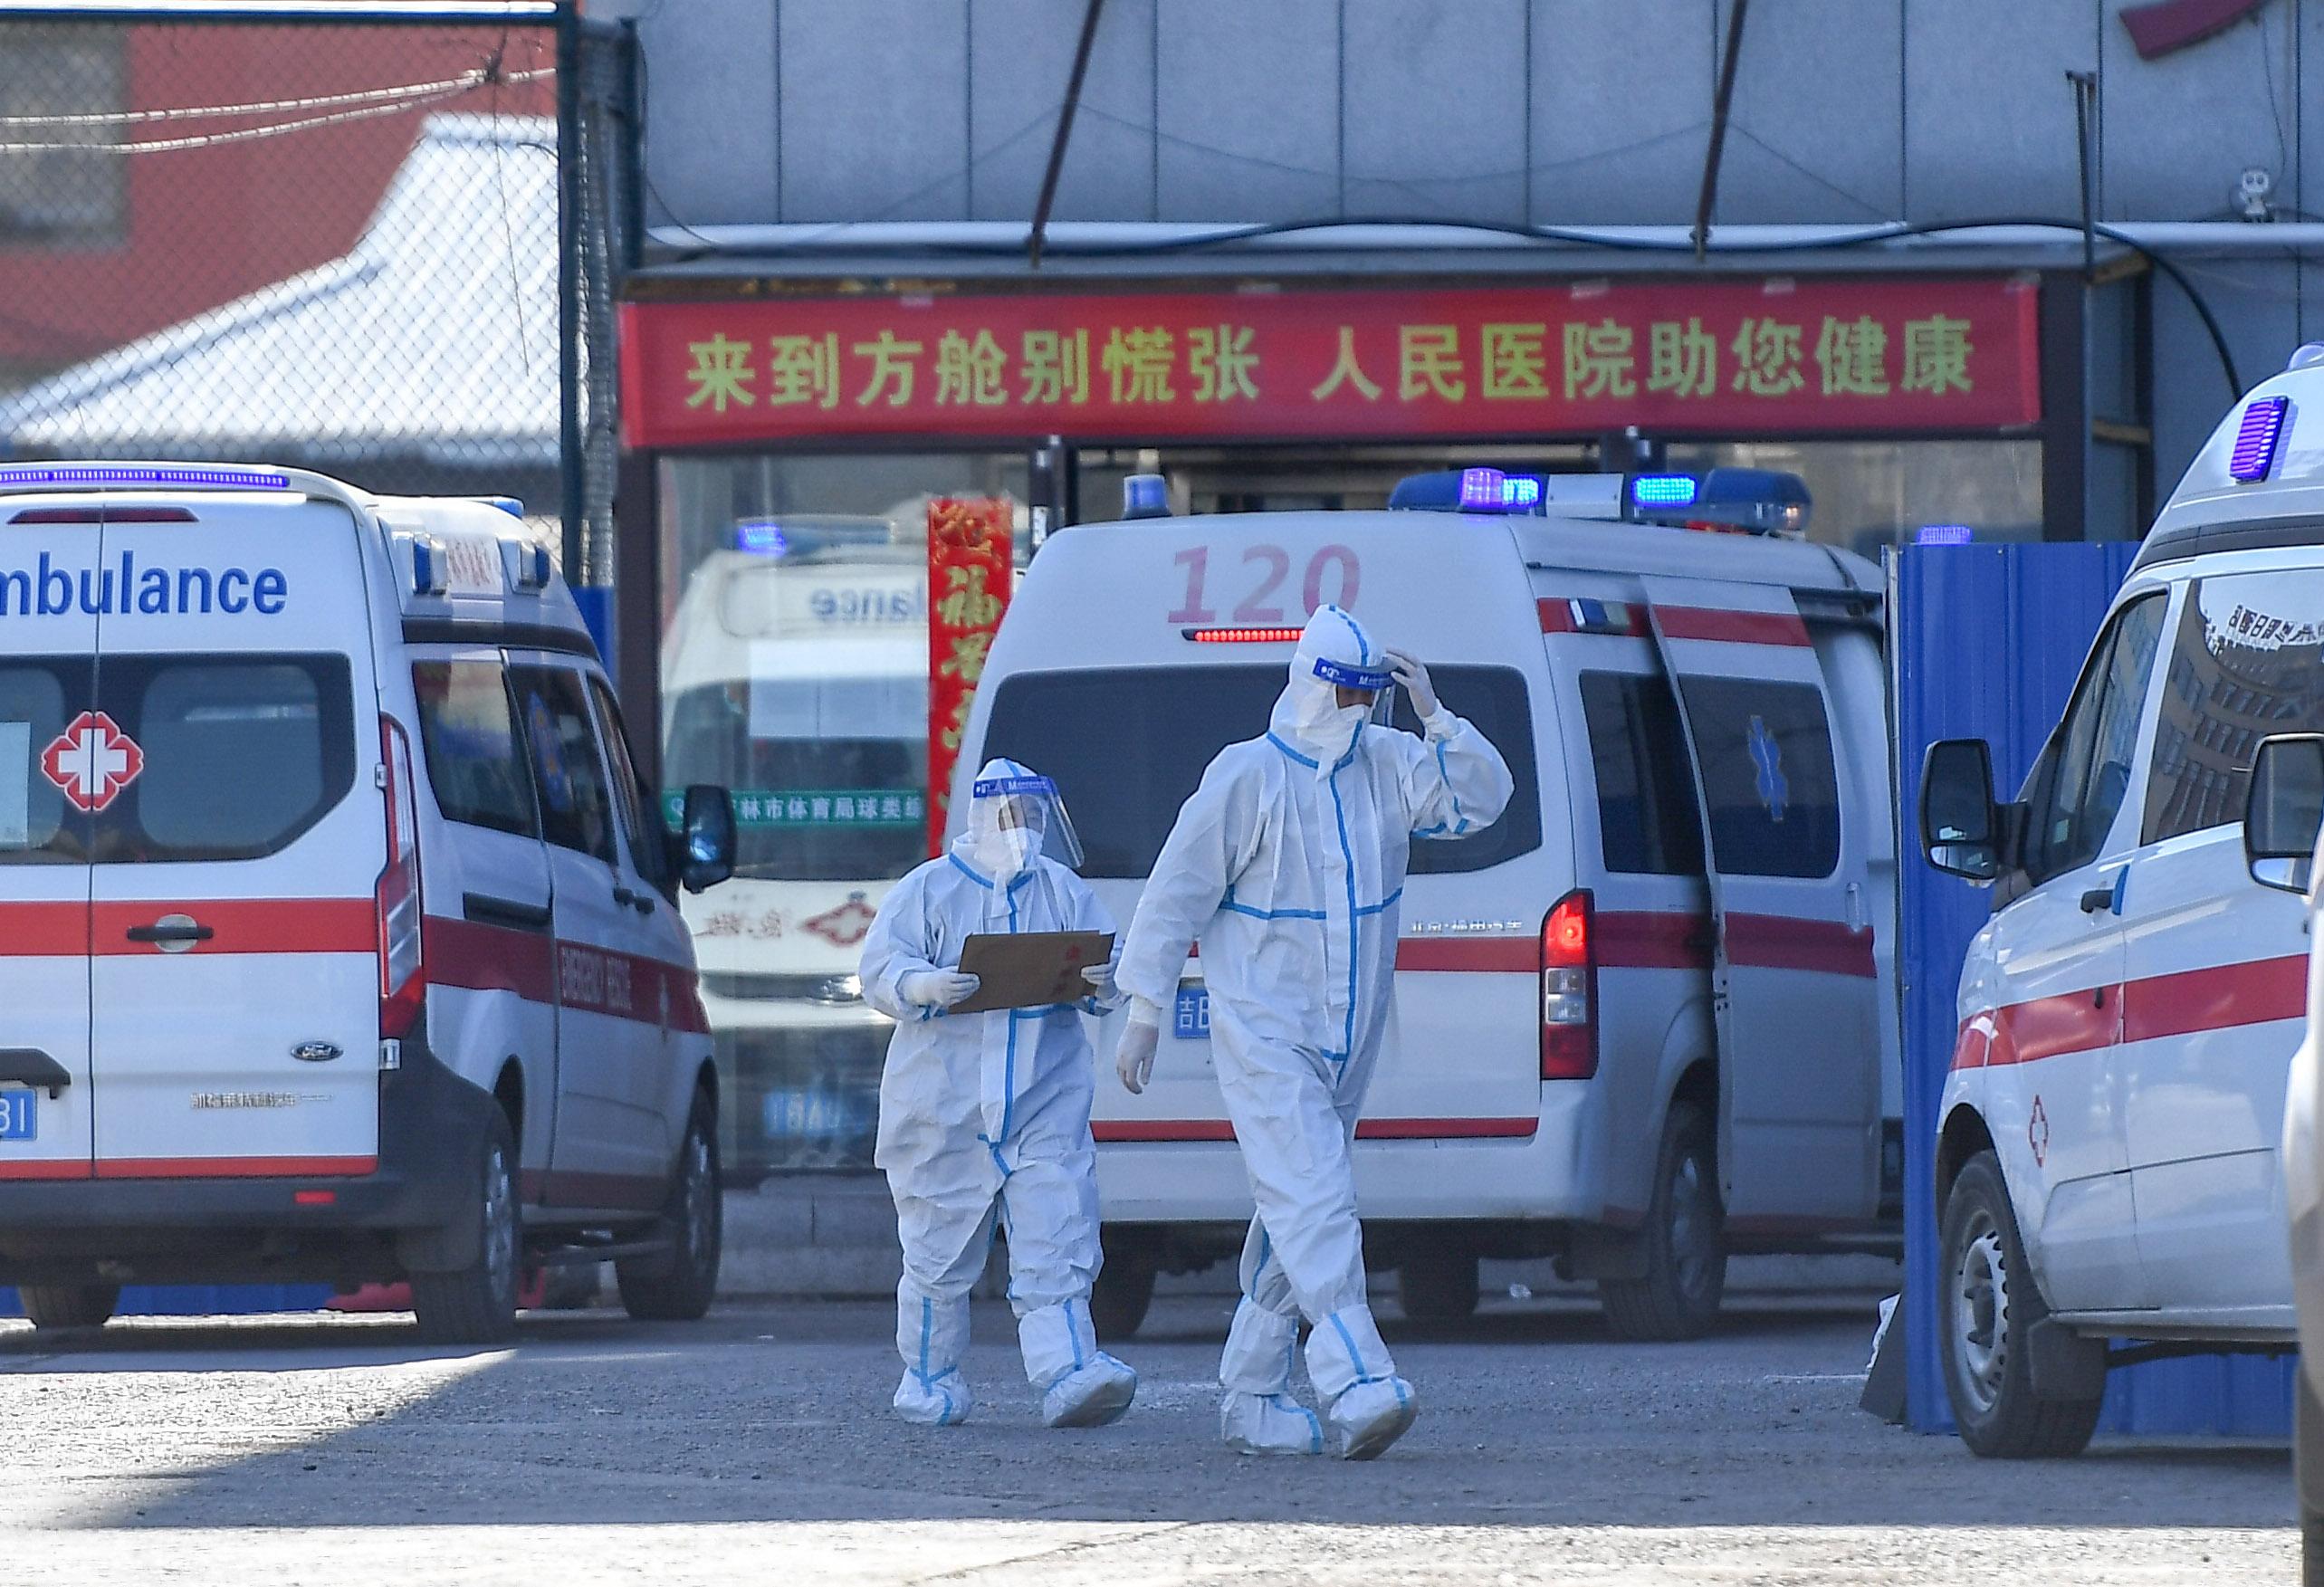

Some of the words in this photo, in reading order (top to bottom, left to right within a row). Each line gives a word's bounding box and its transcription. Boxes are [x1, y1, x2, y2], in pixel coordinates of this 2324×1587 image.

[685, 323, 1261, 412] 来到方舱别慌张
[1310, 313, 1974, 401] 人民医院助您健康
[0, 550, 288, 615] mbulance
[1168, 543, 1360, 623] 120
